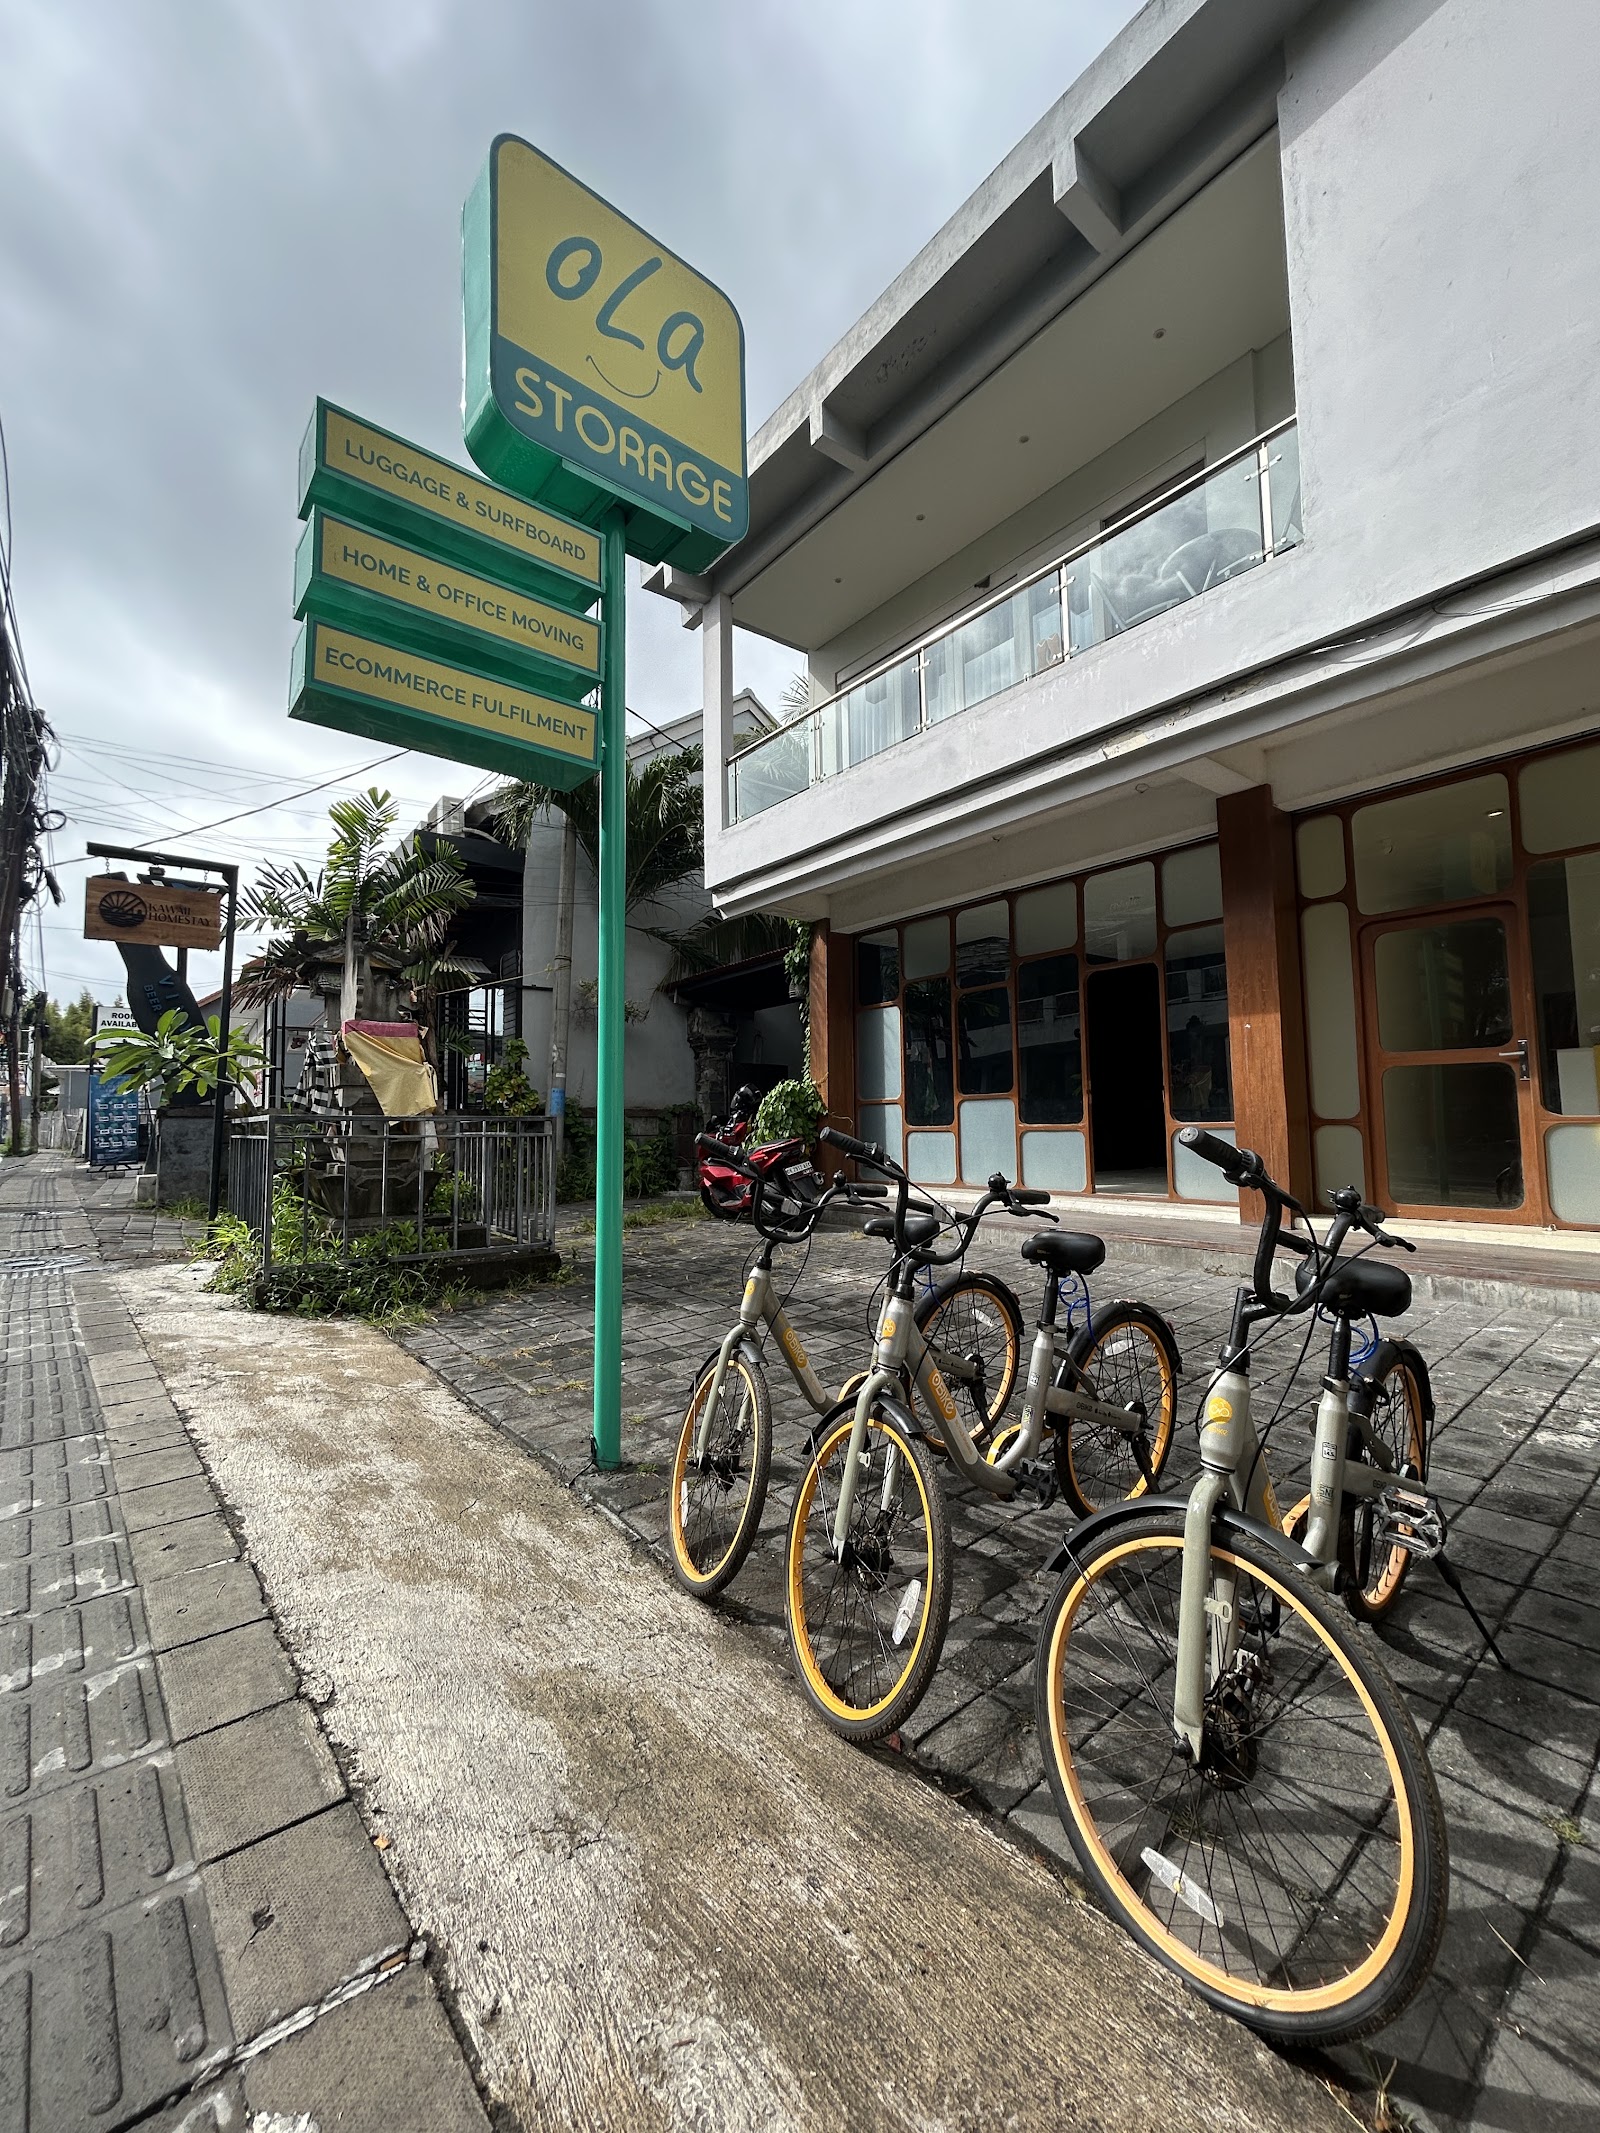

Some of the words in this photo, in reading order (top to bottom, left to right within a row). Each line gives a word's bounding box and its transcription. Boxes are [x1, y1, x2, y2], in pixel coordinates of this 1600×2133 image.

[515, 367, 732, 523] STORAGE
[345, 438, 451, 501] LUGGAGE
[456, 491, 470, 510] &
[475, 500, 586, 561] SURFBOARD
[342, 545, 411, 586] HOME
[416, 575, 431, 592] &
[436, 583, 506, 622] OFFICE
[512, 610, 584, 651] MOVING
[325, 646, 465, 705] ECOMMERCE
[472, 694, 588, 741] FULFILMENT
[150, 903, 191, 915] KAWAII
[150, 913, 211, 927] HOMESTAY
[100, 1020, 137, 1028] AVAILAB
[144, 984, 163, 1012] BEER
